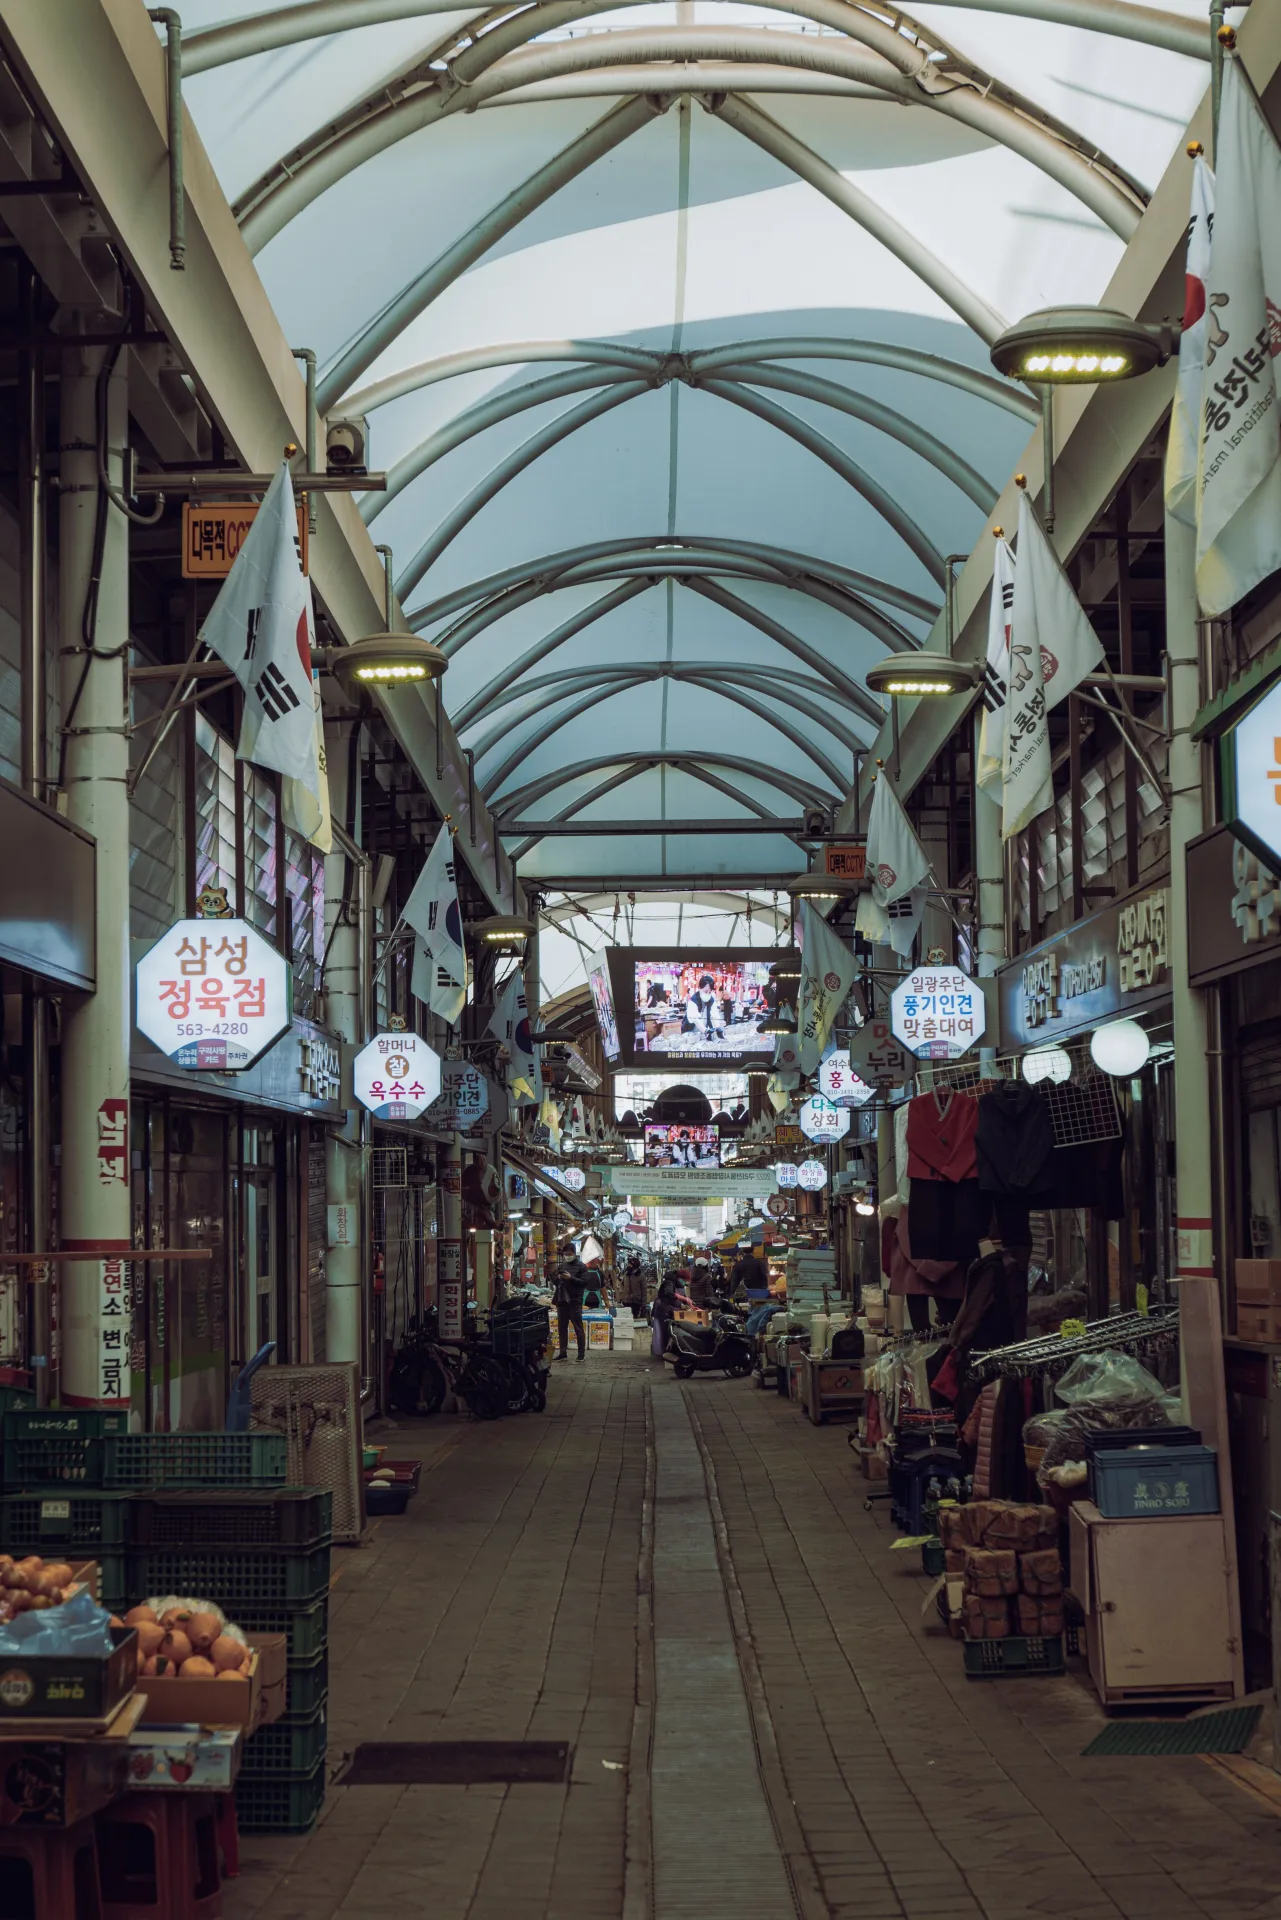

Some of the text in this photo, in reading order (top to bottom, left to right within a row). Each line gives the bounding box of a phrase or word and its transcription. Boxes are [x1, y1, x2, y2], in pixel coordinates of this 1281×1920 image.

[192, 520, 254, 560] 다목적 CC
[846, 854, 863, 873] CCTV
[175, 936, 248, 976] 삼성
[911, 976, 966, 993] 일광주단
[159, 978, 265, 1019] 정육점
[903, 995, 973, 1016] 풍기인견
[177, 1022, 248, 1036] 563-4280
[904, 1017, 974, 1039] 맞춤대여
[378, 1039, 416, 1053] 할머니
[389, 1057, 406, 1076] 찰
[828, 1059, 850, 1069] 여수
[867, 1052, 905, 1072] 누리
[369, 1081, 426, 1100] 옥수수
[811, 1113, 838, 1127] 상회
[444, 1286, 459, 1320] 화장실
[1134, 1496, 1190, 1510] JINRO SOJU
